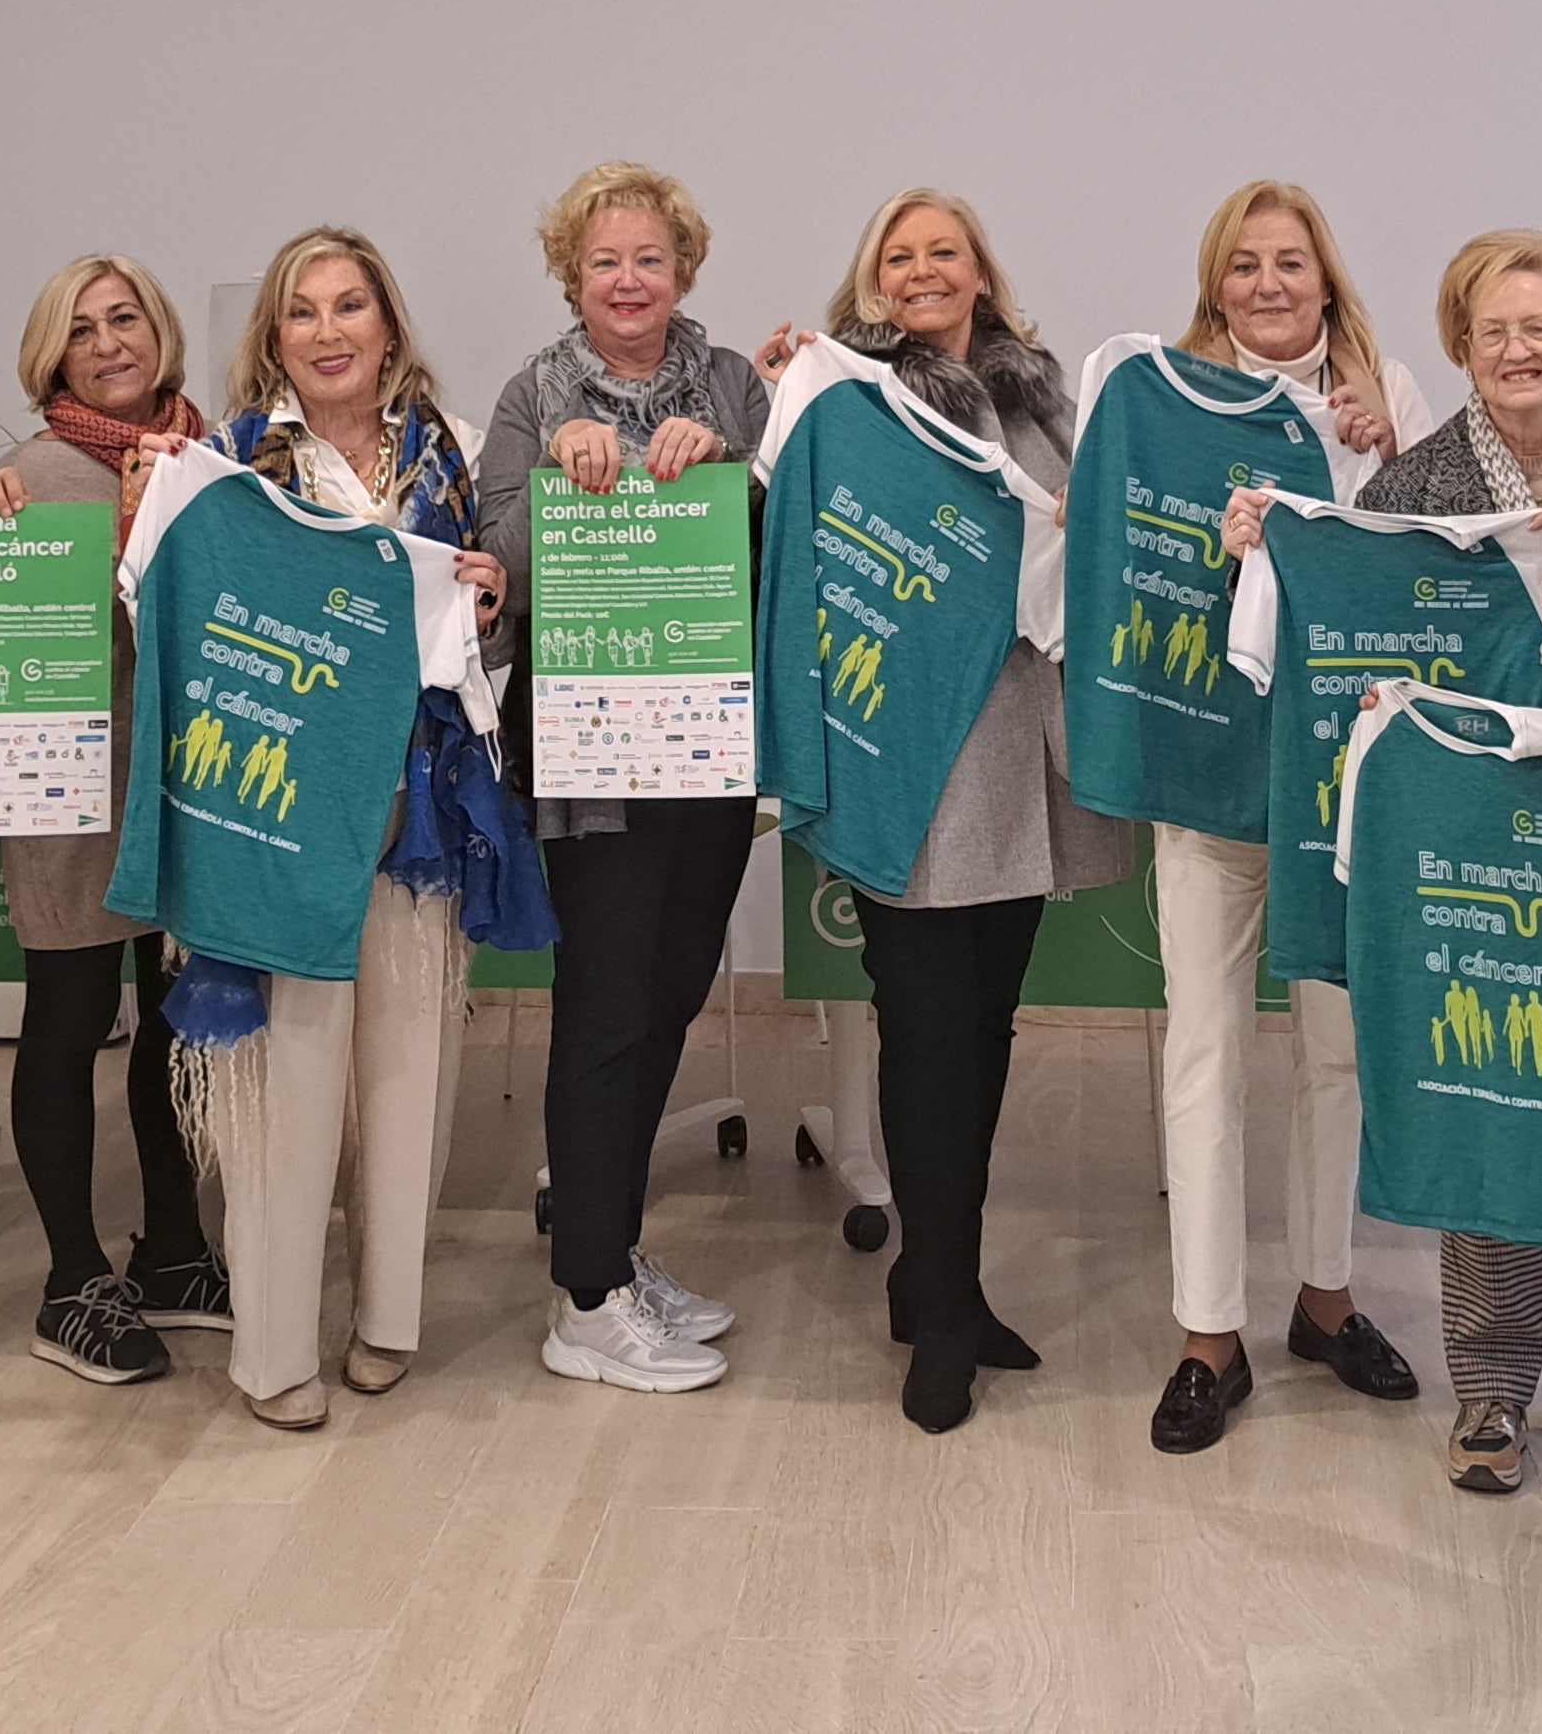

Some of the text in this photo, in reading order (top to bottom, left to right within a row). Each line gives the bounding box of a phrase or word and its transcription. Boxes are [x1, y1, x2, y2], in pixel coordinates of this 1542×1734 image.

[540, 477, 572, 496] VIII
[541, 499, 711, 521] contra el cáncer
[1126, 476, 1226, 530] En marc
[541, 524, 657, 545] en Castelló
[829, 484, 864, 523] En
[866, 513, 951, 583] marcha
[1126, 523, 1195, 563] ontra
[812, 527, 889, 588] contra
[1132, 569, 1219, 611] cáncer
[822, 581, 900, 640] cáncer
[213, 591, 249, 626] En
[254, 613, 352, 667] marcha
[1308, 624, 1463, 653] En marcha
[201, 639, 284, 685] contra
[1311, 671, 1404, 695] cont
[185, 676, 304, 736] el cáncer
[1313, 711, 1339, 739] el
[1418, 850, 1453, 880] En
[1422, 904, 1507, 935] contra
[1425, 943, 1450, 973] el
[1417, 1079, 1471, 1096] ASOCIACIÓN
[1472, 1087, 1510, 1106] ESPAÑOLA
